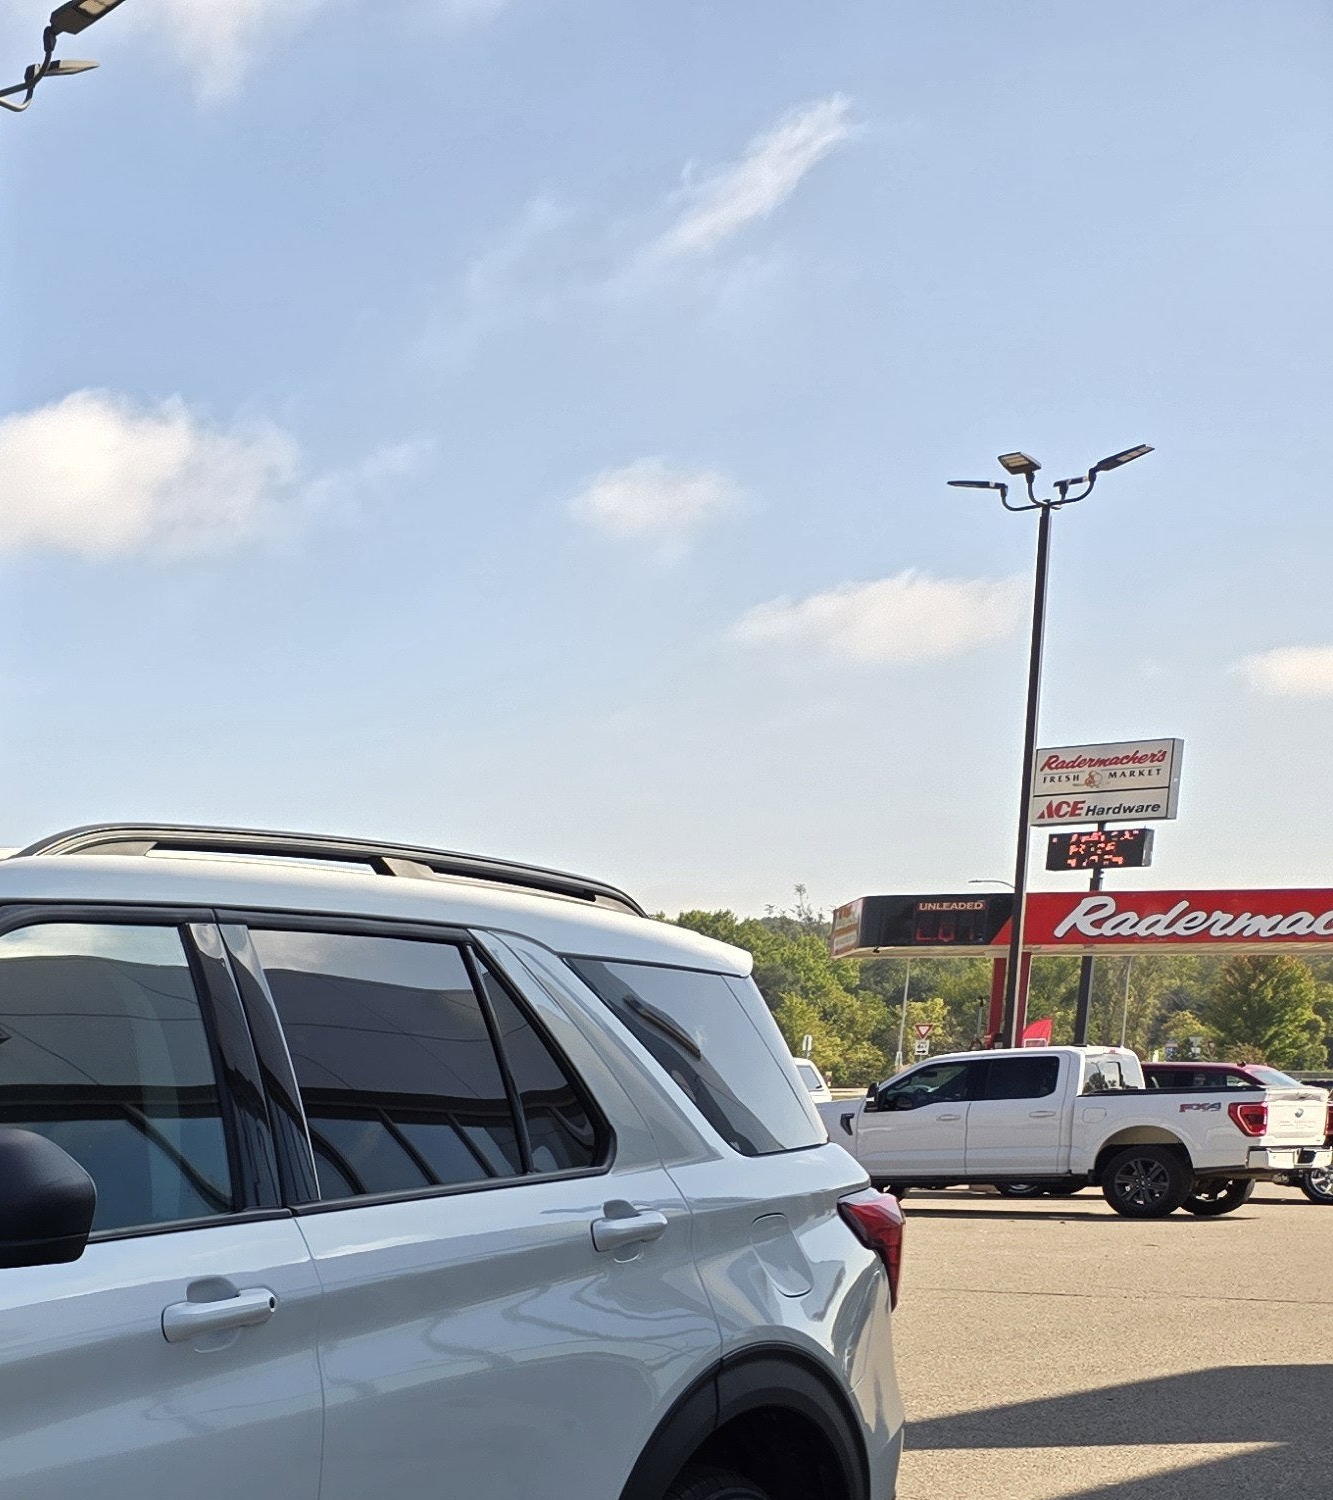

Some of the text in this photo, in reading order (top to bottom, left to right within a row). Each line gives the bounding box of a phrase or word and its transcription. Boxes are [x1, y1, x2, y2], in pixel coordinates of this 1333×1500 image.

[1040, 750, 1167, 772] Radermacher's
[1043, 768, 1162, 784] FRESH MARKET
[1036, 800, 1161, 820] ACE Hardware
[919, 901, 983, 911] UNLEADED
[1179, 1102, 1222, 1113] FX4
